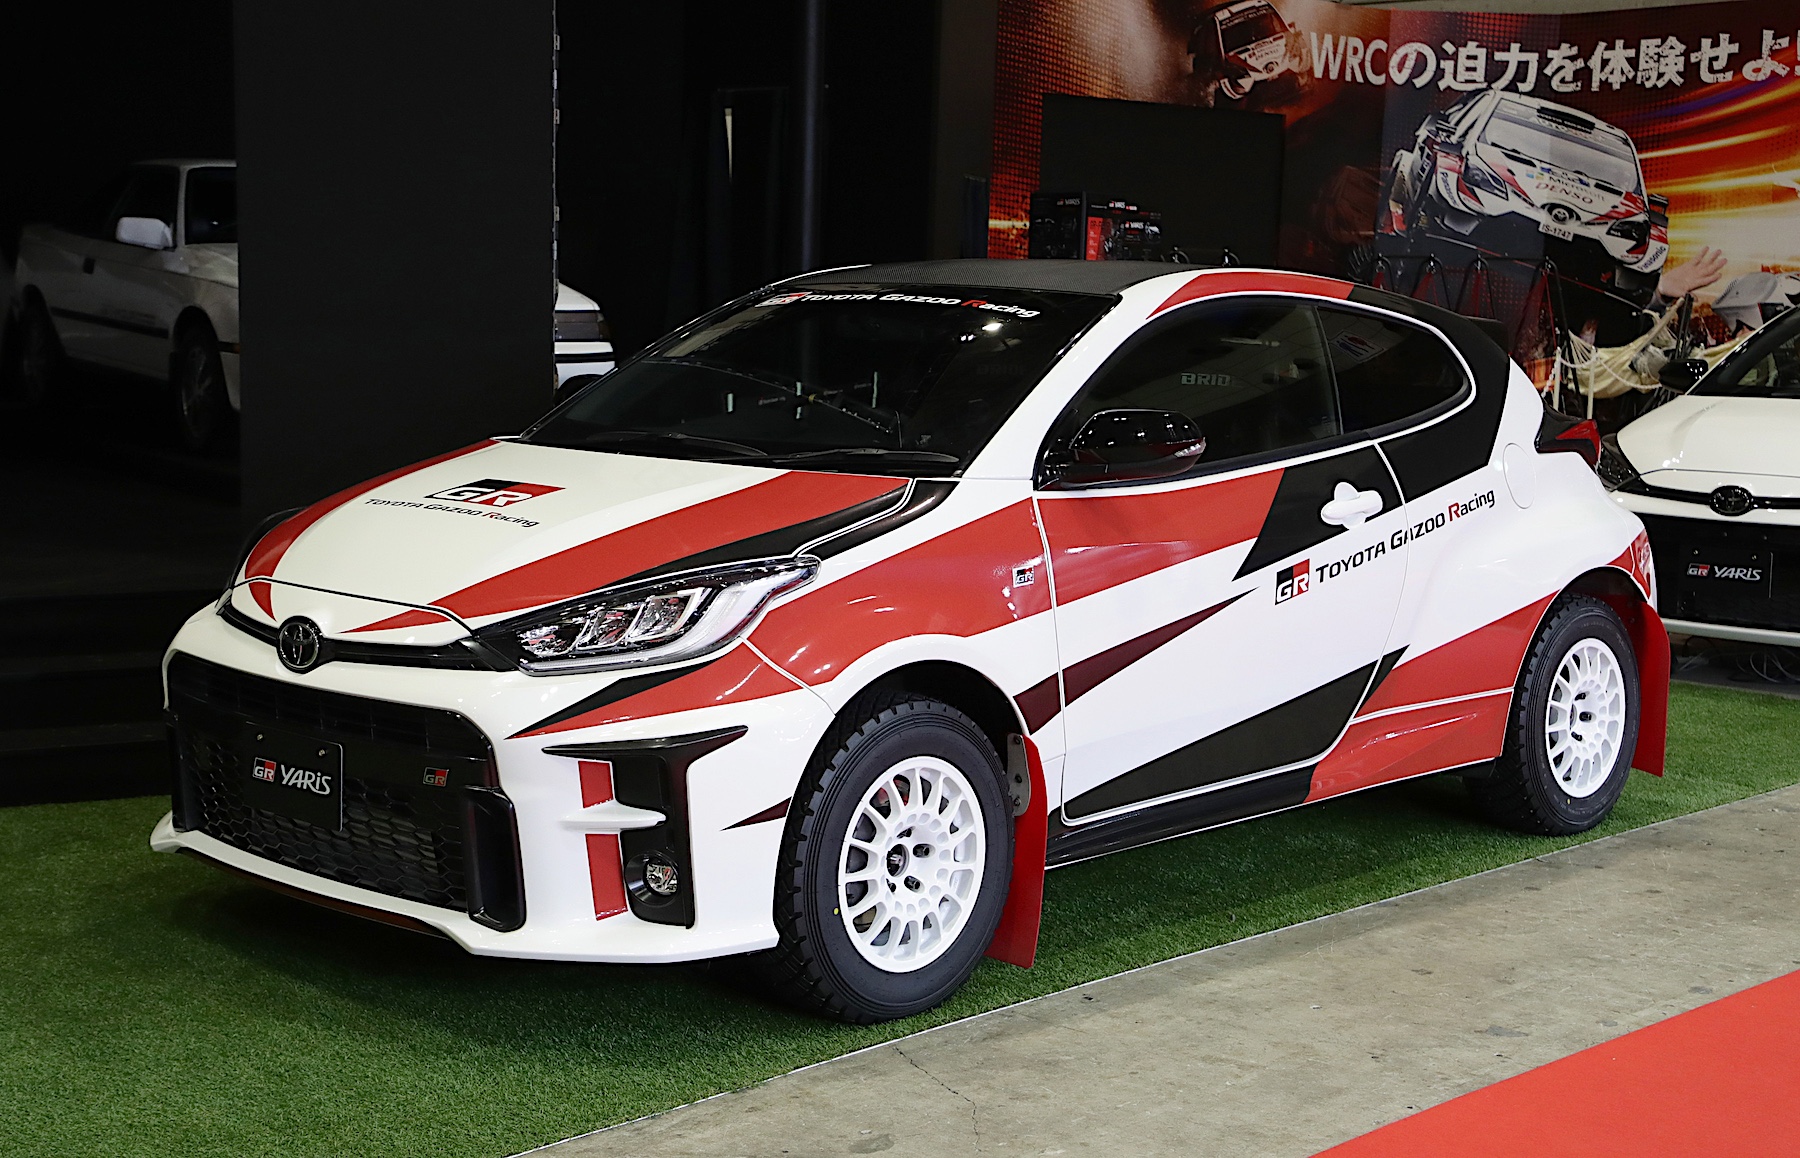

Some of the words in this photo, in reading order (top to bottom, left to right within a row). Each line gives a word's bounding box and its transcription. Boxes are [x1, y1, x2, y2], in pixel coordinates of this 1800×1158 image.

[1536, 182, 1593, 204] DENSO
[801, 294, 877, 302] TOYOTA
[879, 294, 961, 305] GAZOO
[960, 300, 1040, 318] Racing
[364, 498, 424, 508] TOYOTA
[423, 503, 483, 516] GAZOO
[482, 511, 540, 528] Racing
[1276, 572, 1310, 603] GR
[1315, 541, 1386, 584] TOYOTA
[1390, 512, 1446, 551] GAZOO
[1448, 490, 1495, 522] Racing
